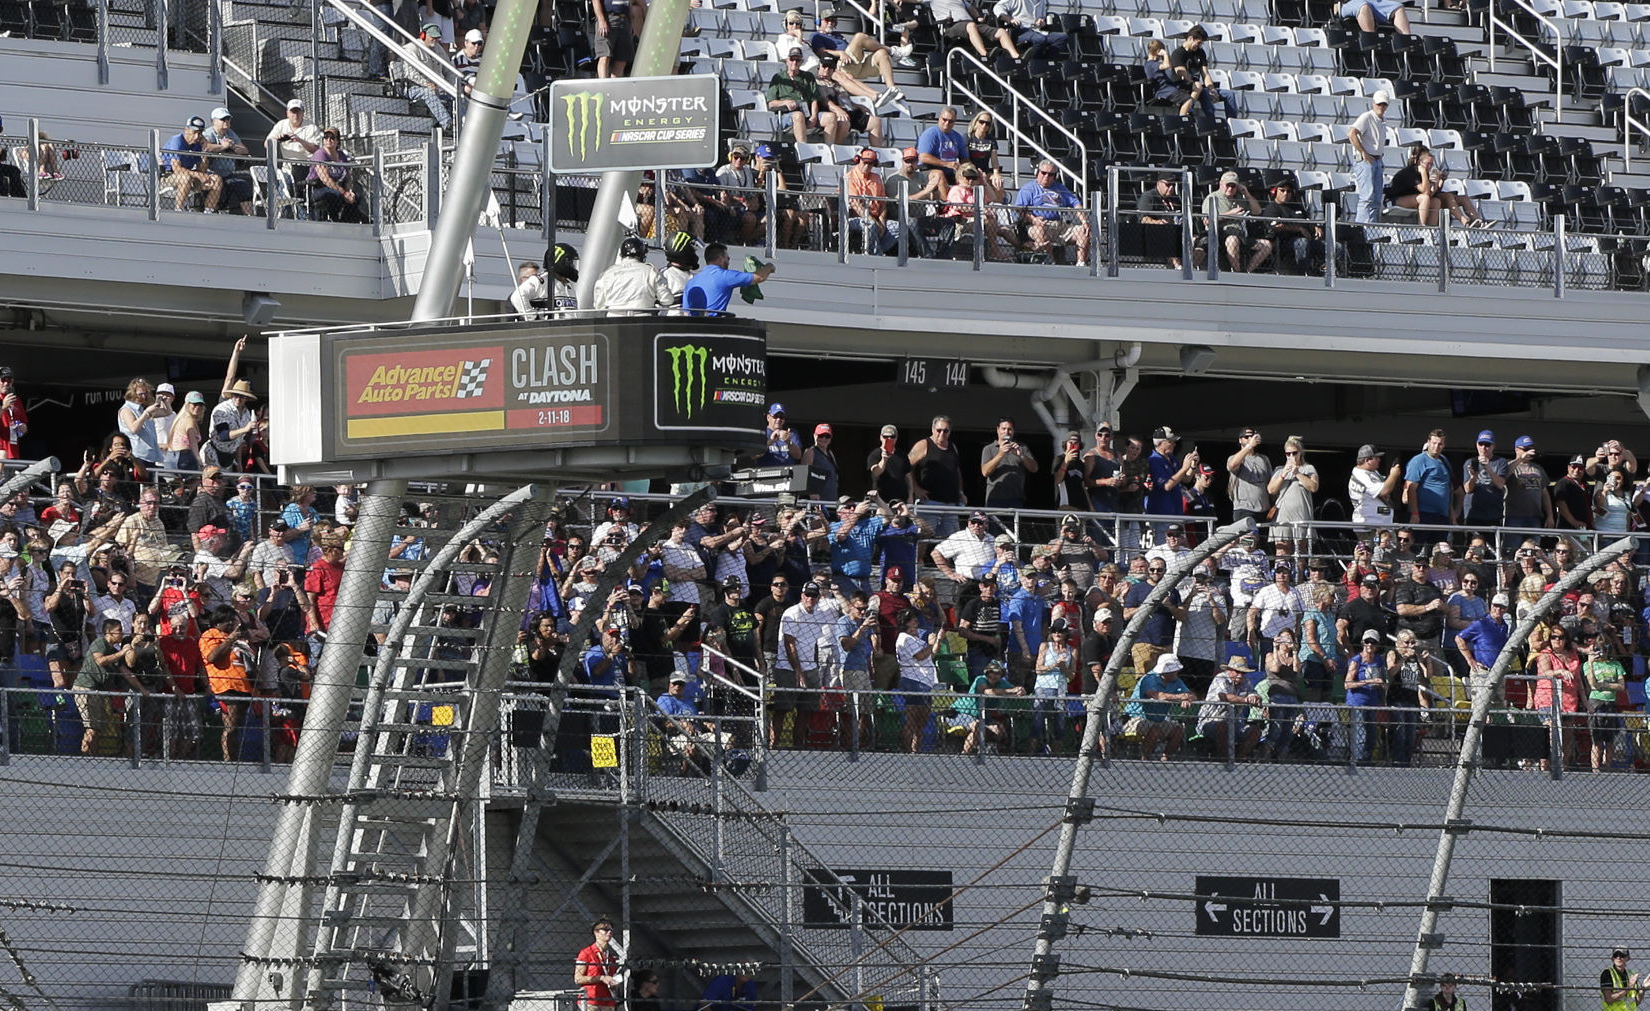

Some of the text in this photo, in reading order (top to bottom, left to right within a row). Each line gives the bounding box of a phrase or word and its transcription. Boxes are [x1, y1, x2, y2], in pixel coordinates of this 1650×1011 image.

[609, 94, 708, 117] MONSTER
[624, 116, 693, 126] ENERGY
[621, 128, 706, 142] NASCAR CUP SERIES
[370, 364, 456, 388] Advance
[511, 344, 598, 390] CLASH
[712, 352, 765, 377] MONSTER
[905, 360, 966, 386] 145 144
[358, 381, 453, 404] Auto Parts
[724, 377, 761, 387] ENERGY
[517, 389, 593, 404] AT DAYTONA
[537, 409, 571, 426] 2-11-18
[868, 874, 895, 898] ALL
[1253, 882, 1280, 907] ALL
[867, 901, 944, 927] SECTIONS
[1232, 908, 1307, 934] SECTIONS
